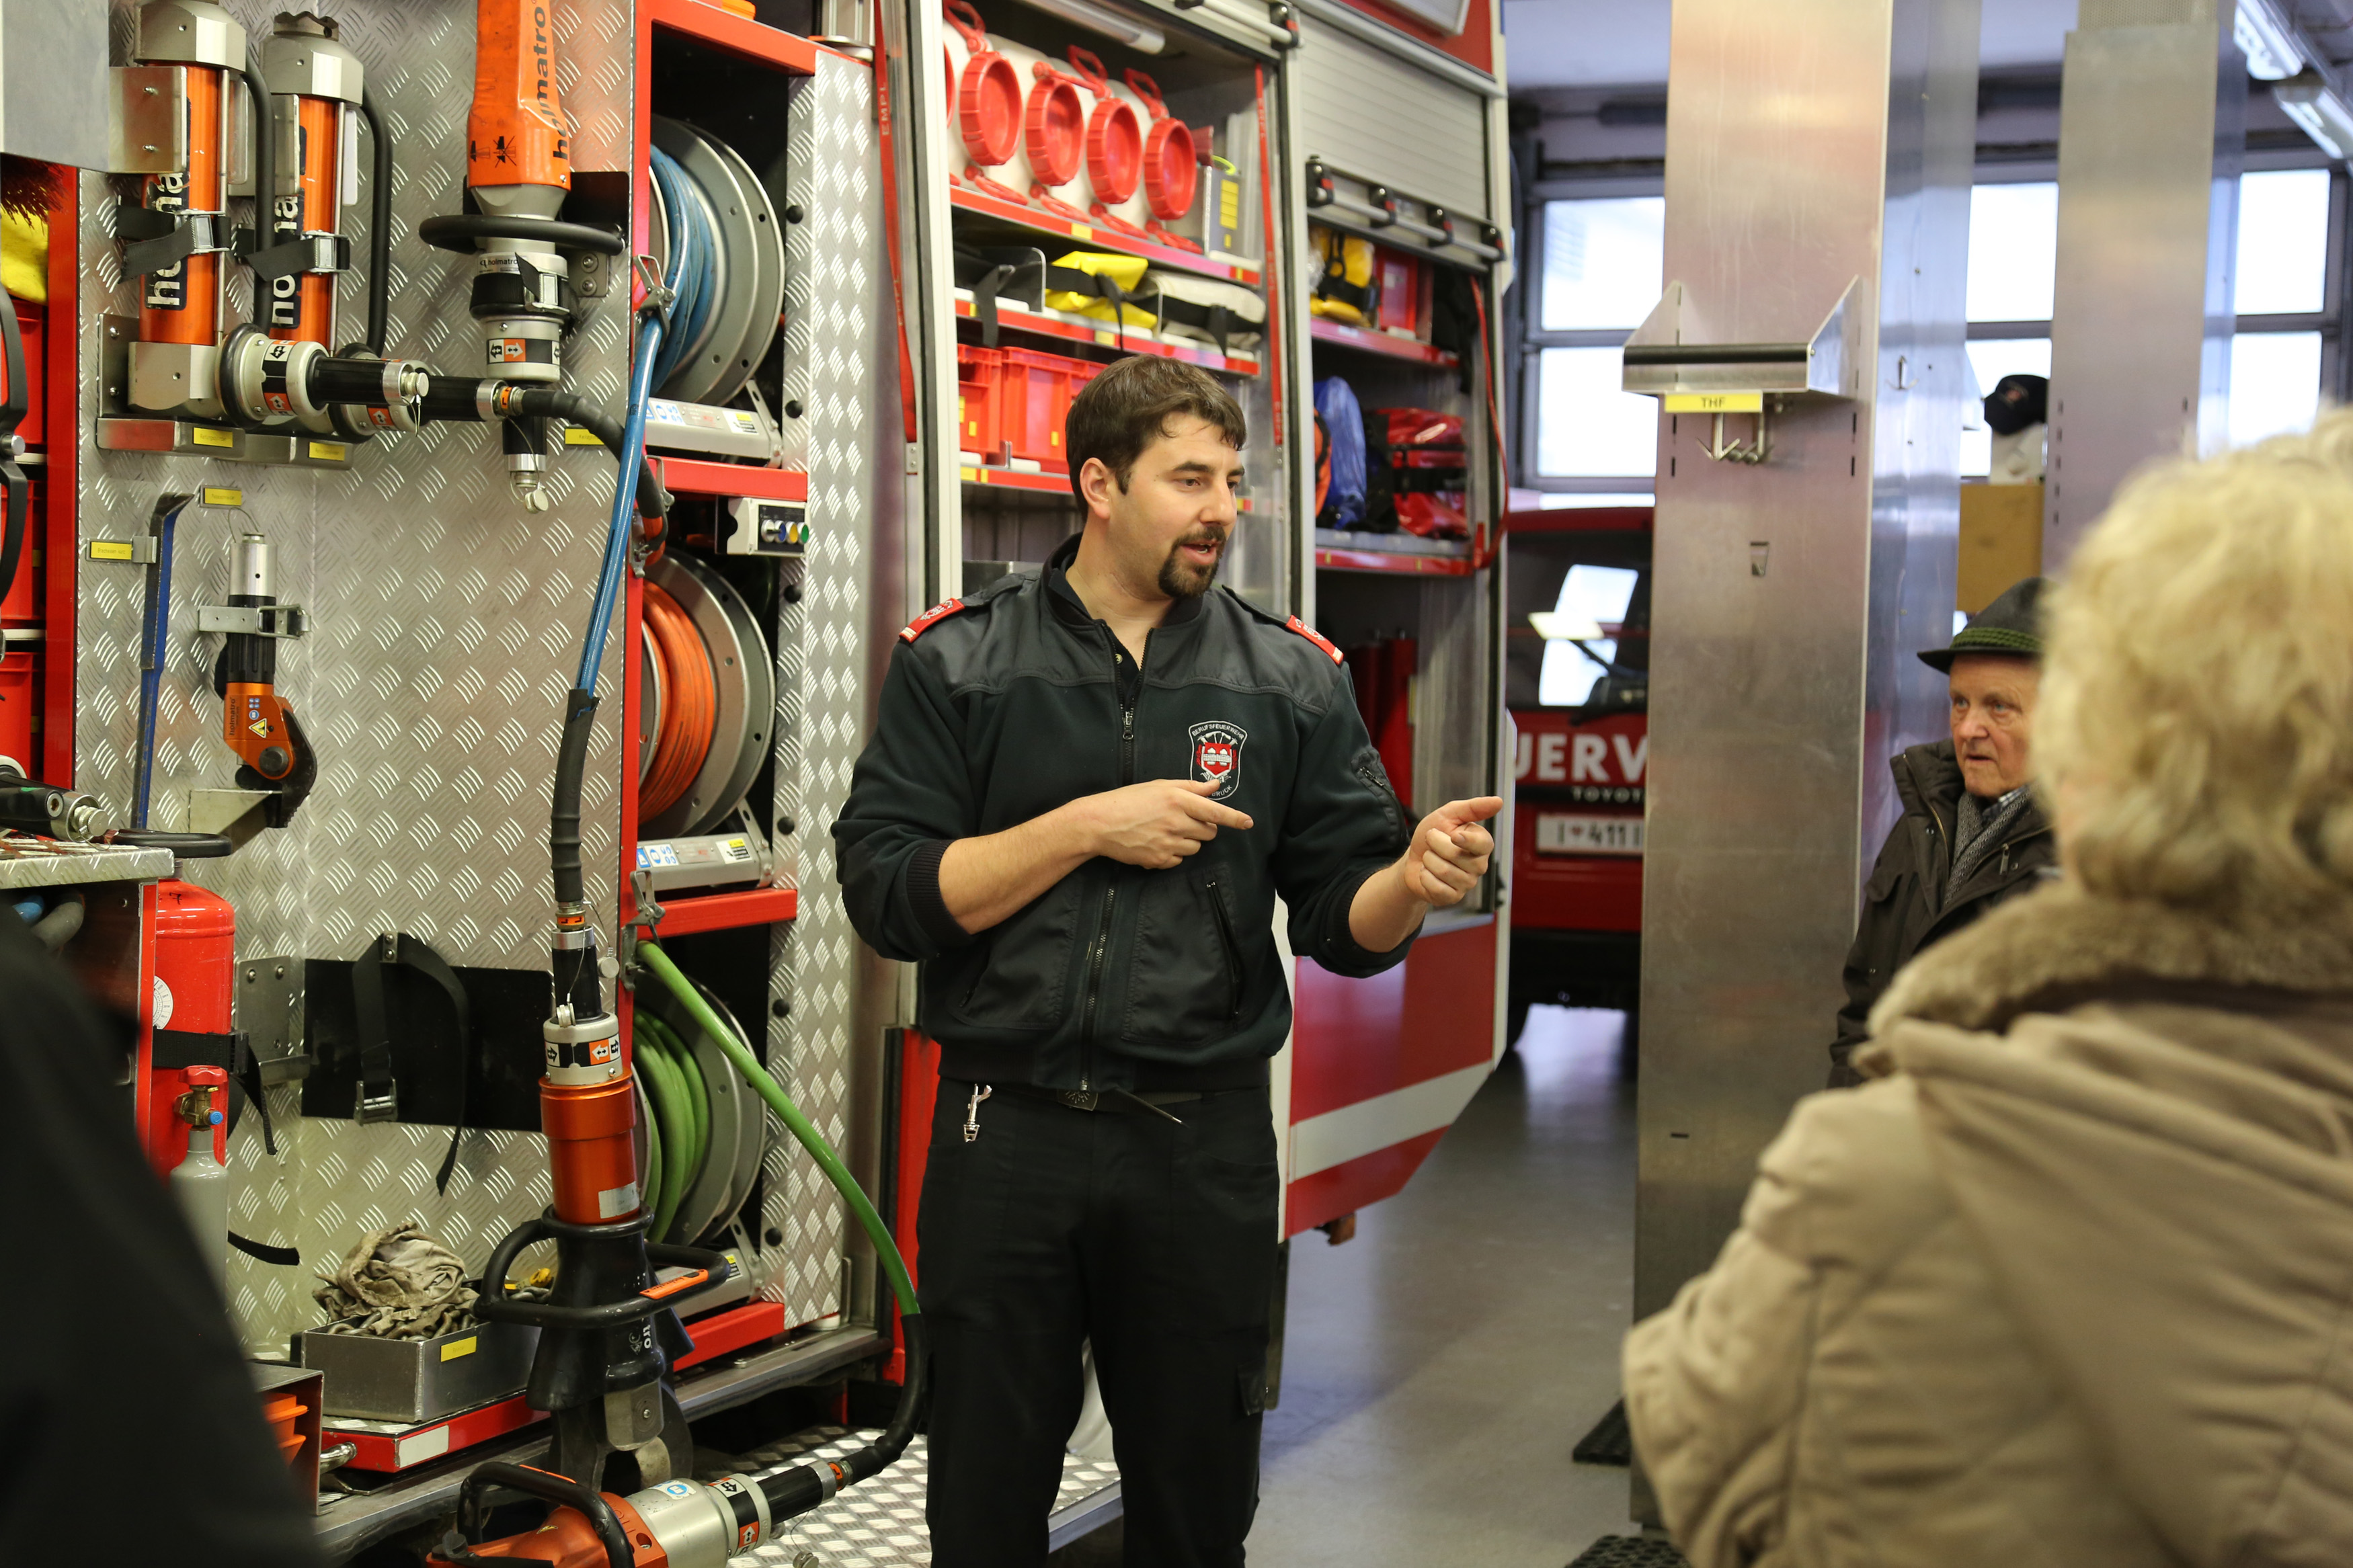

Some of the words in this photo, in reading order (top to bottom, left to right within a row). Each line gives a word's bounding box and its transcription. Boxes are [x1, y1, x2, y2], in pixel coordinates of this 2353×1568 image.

[534, 7, 568, 160] holmatro
[1701, 397, 1726, 408] THF
[1192, 724, 1244, 740] BERUFSFEUERWEHR
[1211, 785, 1232, 796] BRUCK
[1571, 786, 1643, 803] TOYOT
